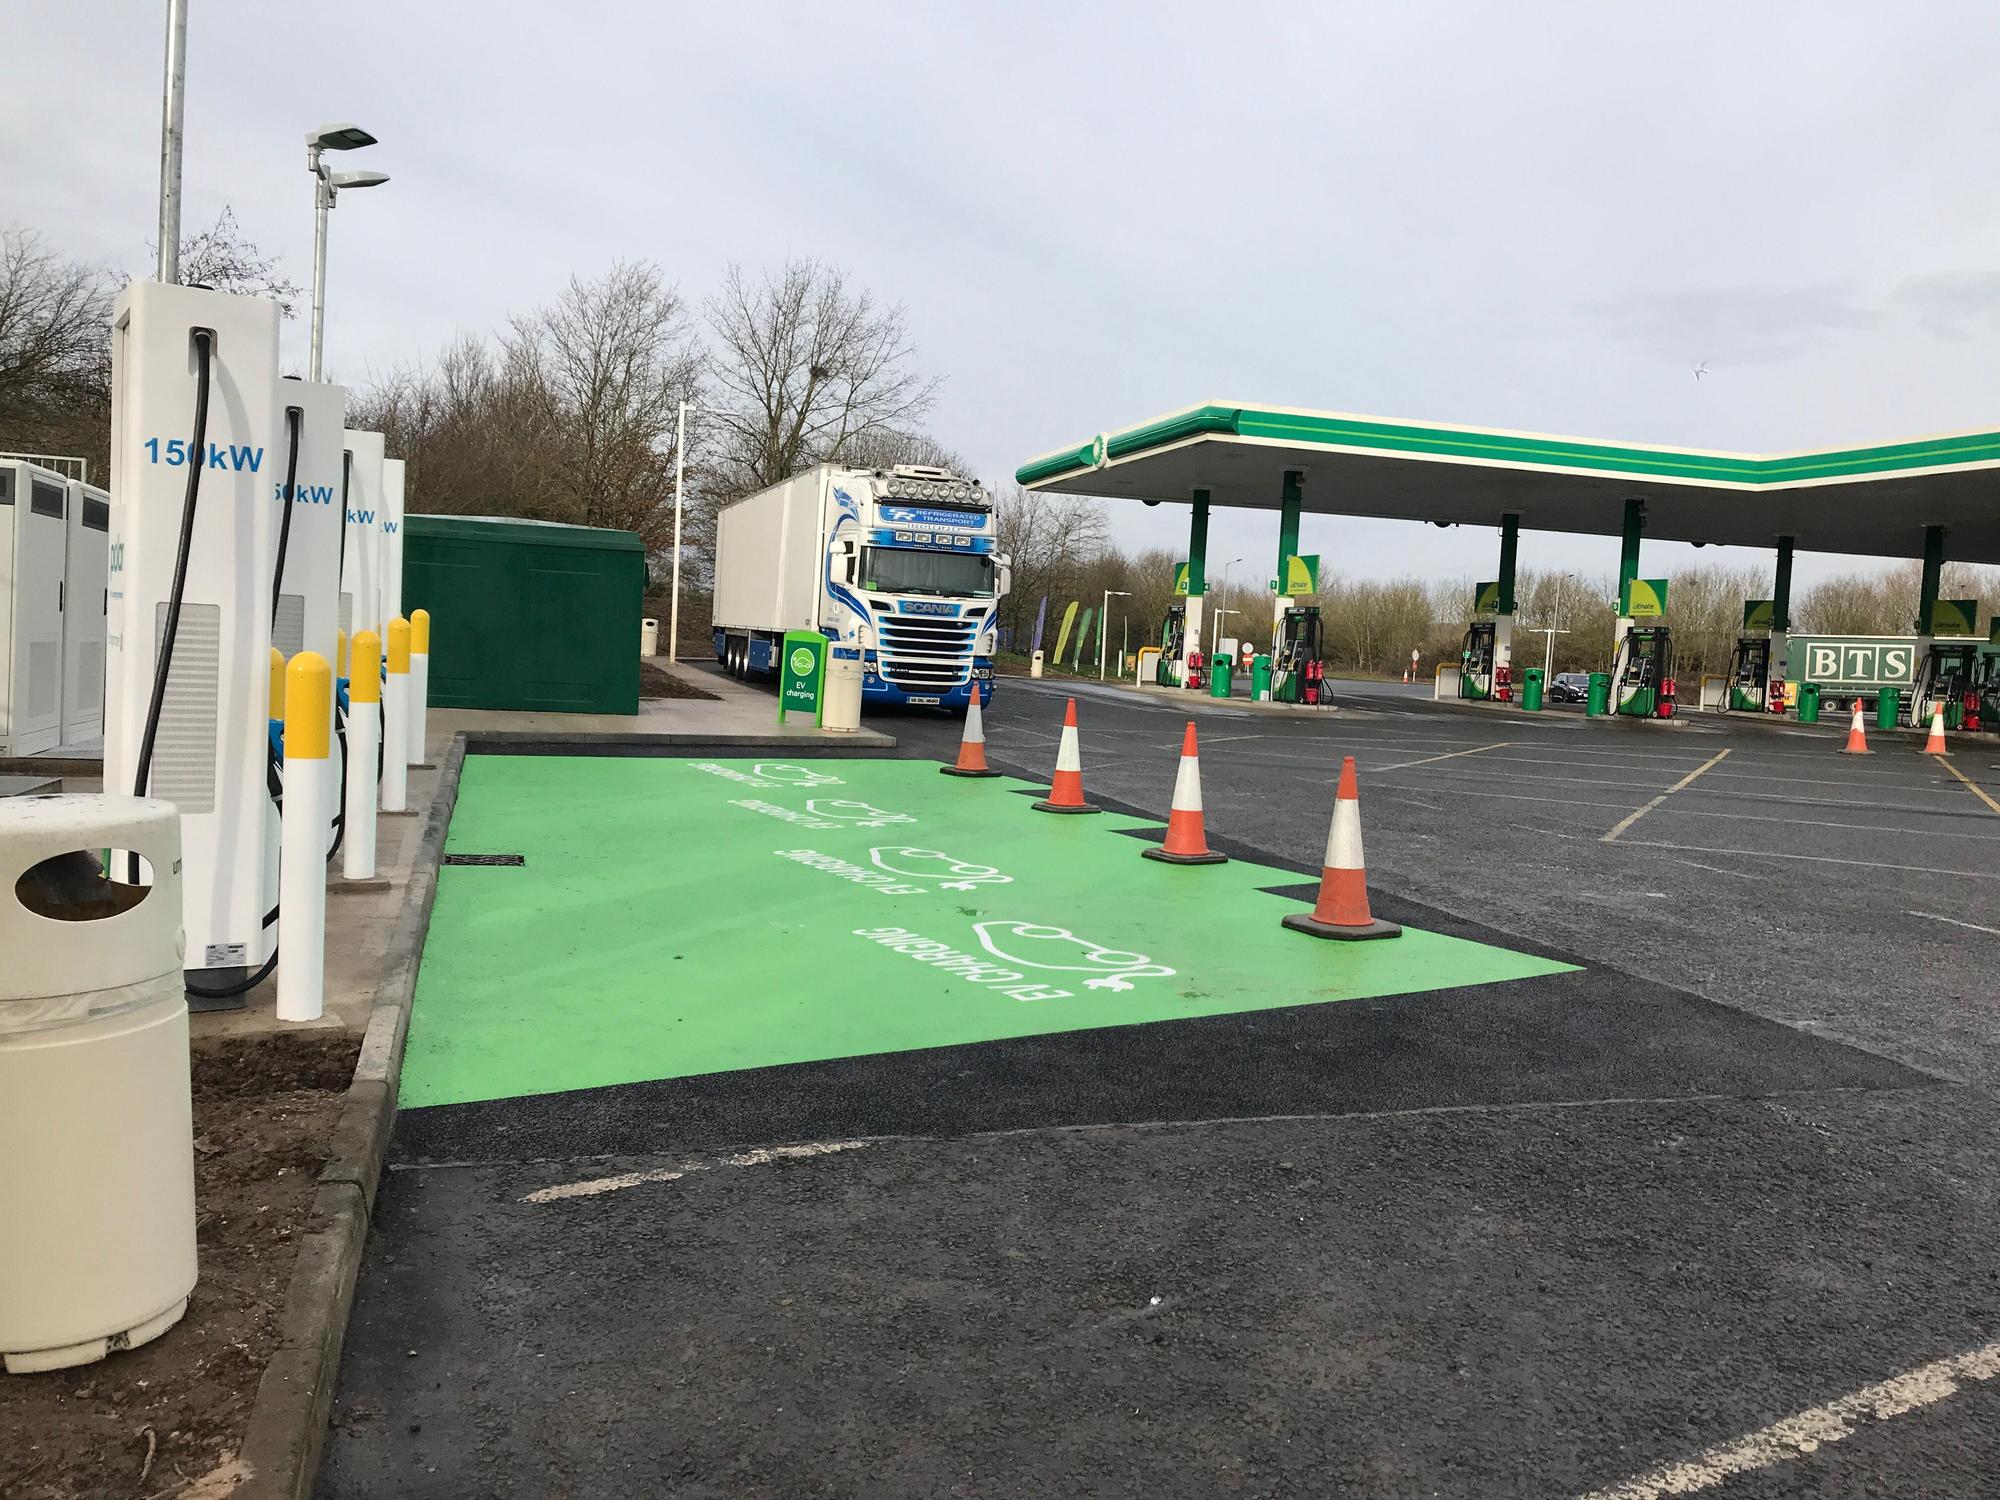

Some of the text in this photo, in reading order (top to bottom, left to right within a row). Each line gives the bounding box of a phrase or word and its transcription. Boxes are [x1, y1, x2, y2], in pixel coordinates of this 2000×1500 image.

[144, 437, 264, 472] 150kW
[916, 510, 981, 521] REFRIGERATED
[922, 515, 975, 525] TRANSPORT
[903, 602, 955, 614] SCANIA
[1812, 648, 1907, 678] BTS
[796, 681, 806, 689] EV
[786, 689, 815, 700] charging
[852, 927, 1075, 1002] EV CHARGING
